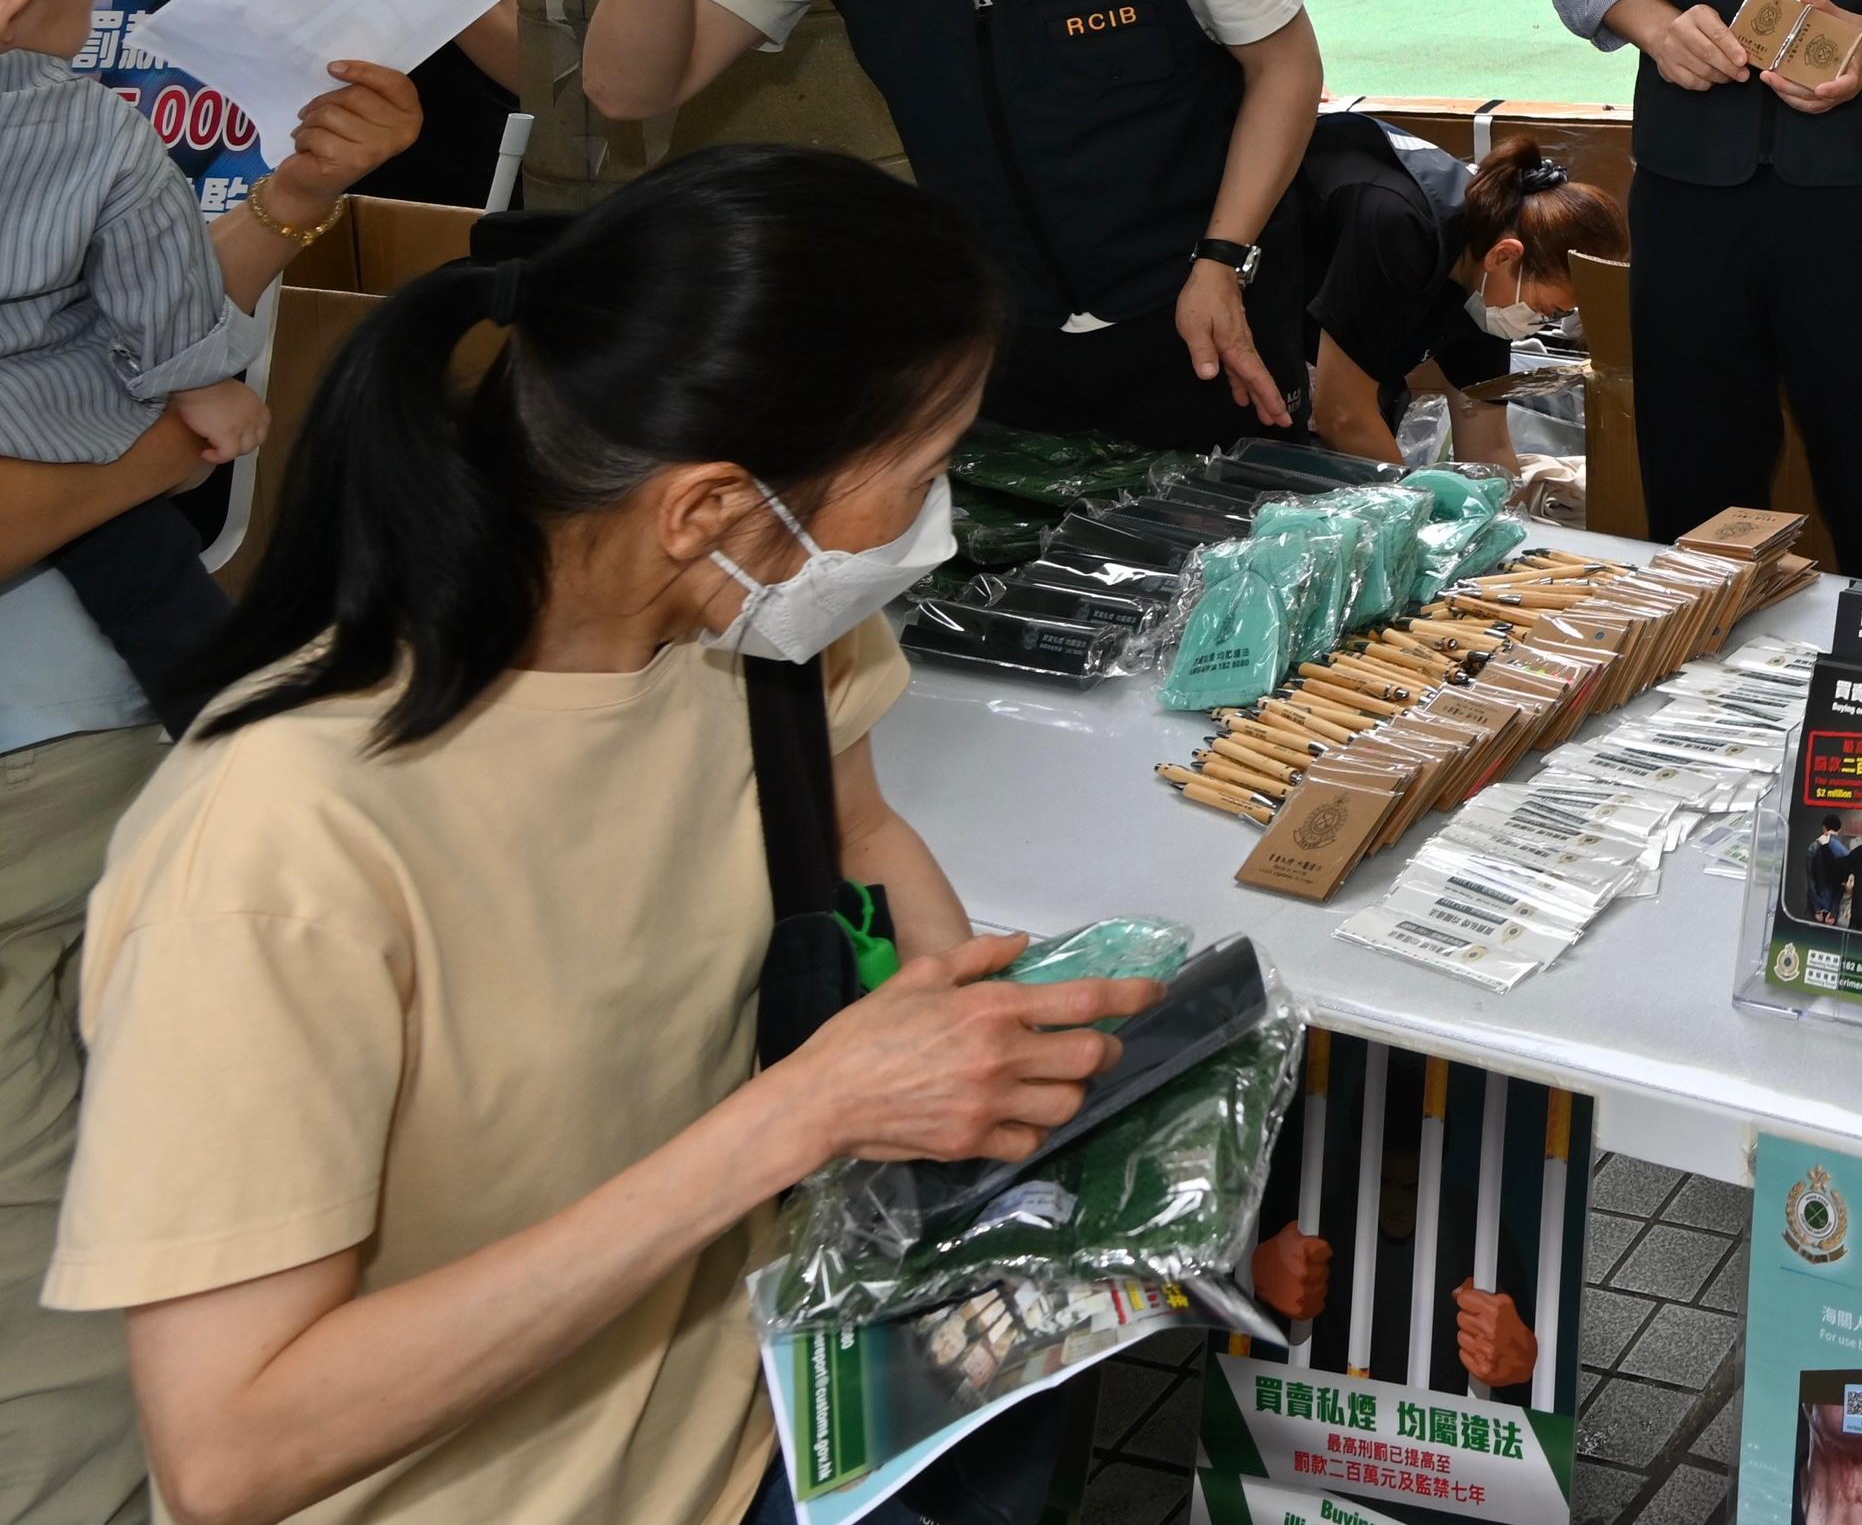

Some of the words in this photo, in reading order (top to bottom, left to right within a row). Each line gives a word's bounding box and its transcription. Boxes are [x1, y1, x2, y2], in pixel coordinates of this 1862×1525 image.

[1066, 6, 1137, 36] RCIB
[1832, 702, 1856, 715] Buying
[1816, 788, 1826, 798] $2
[1827, 790, 1852, 798] million
[1842, 961, 1855, 972] 182
[1819, 1329, 1837, 1343] For
[1838, 1335, 1856, 1349] use
[1254, 1374, 1378, 1433] 買賣私煙
[1396, 1403, 1524, 1461] 均屬違法
[1327, 1433, 1452, 1474] 最高刑罰已提高至
[1294, 1450, 1486, 1506] 罰款二百萬元及監禁七年
